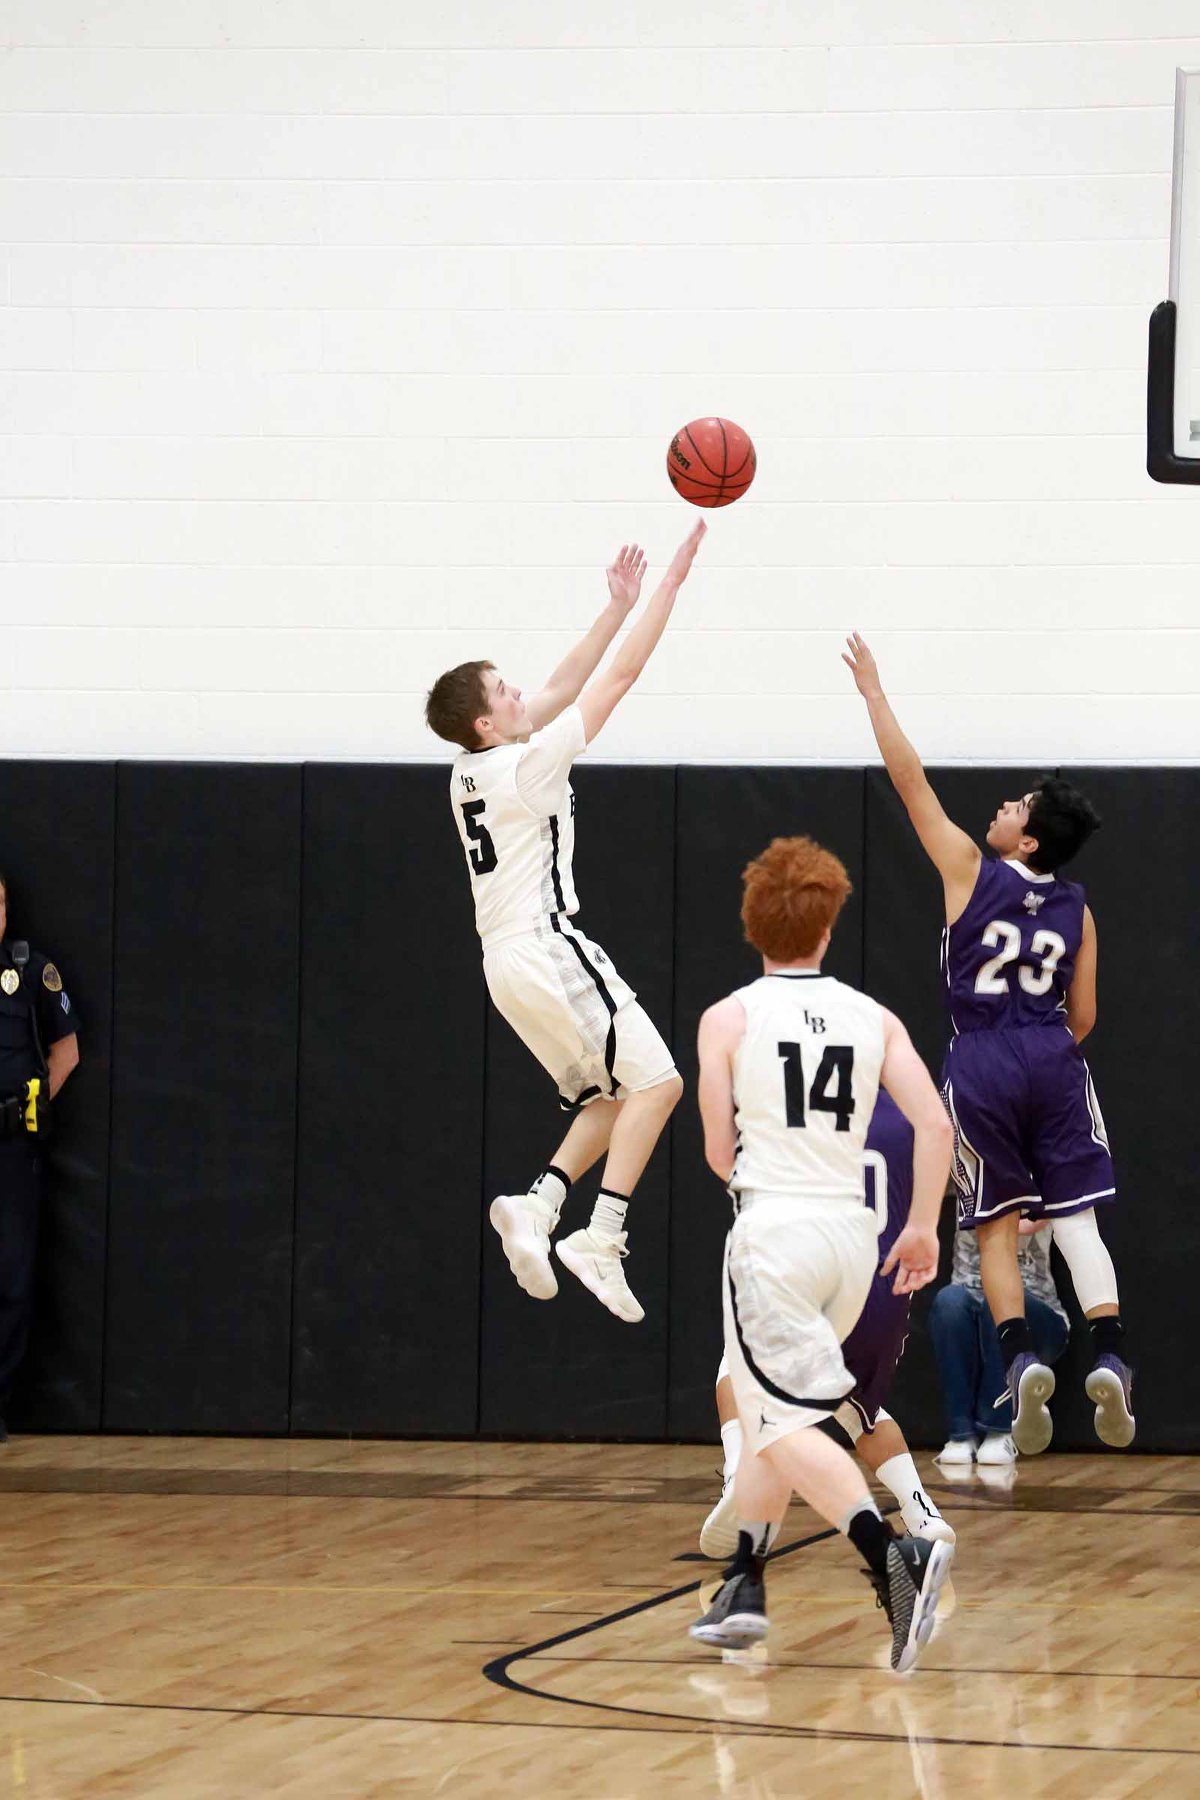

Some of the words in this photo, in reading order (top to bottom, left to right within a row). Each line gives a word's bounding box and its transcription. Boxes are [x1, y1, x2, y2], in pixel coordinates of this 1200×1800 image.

[461, 798, 498, 876] 5
[974, 920, 1066, 995] 23
[804, 1010, 826, 1034] LB
[777, 1041, 855, 1132] 14
